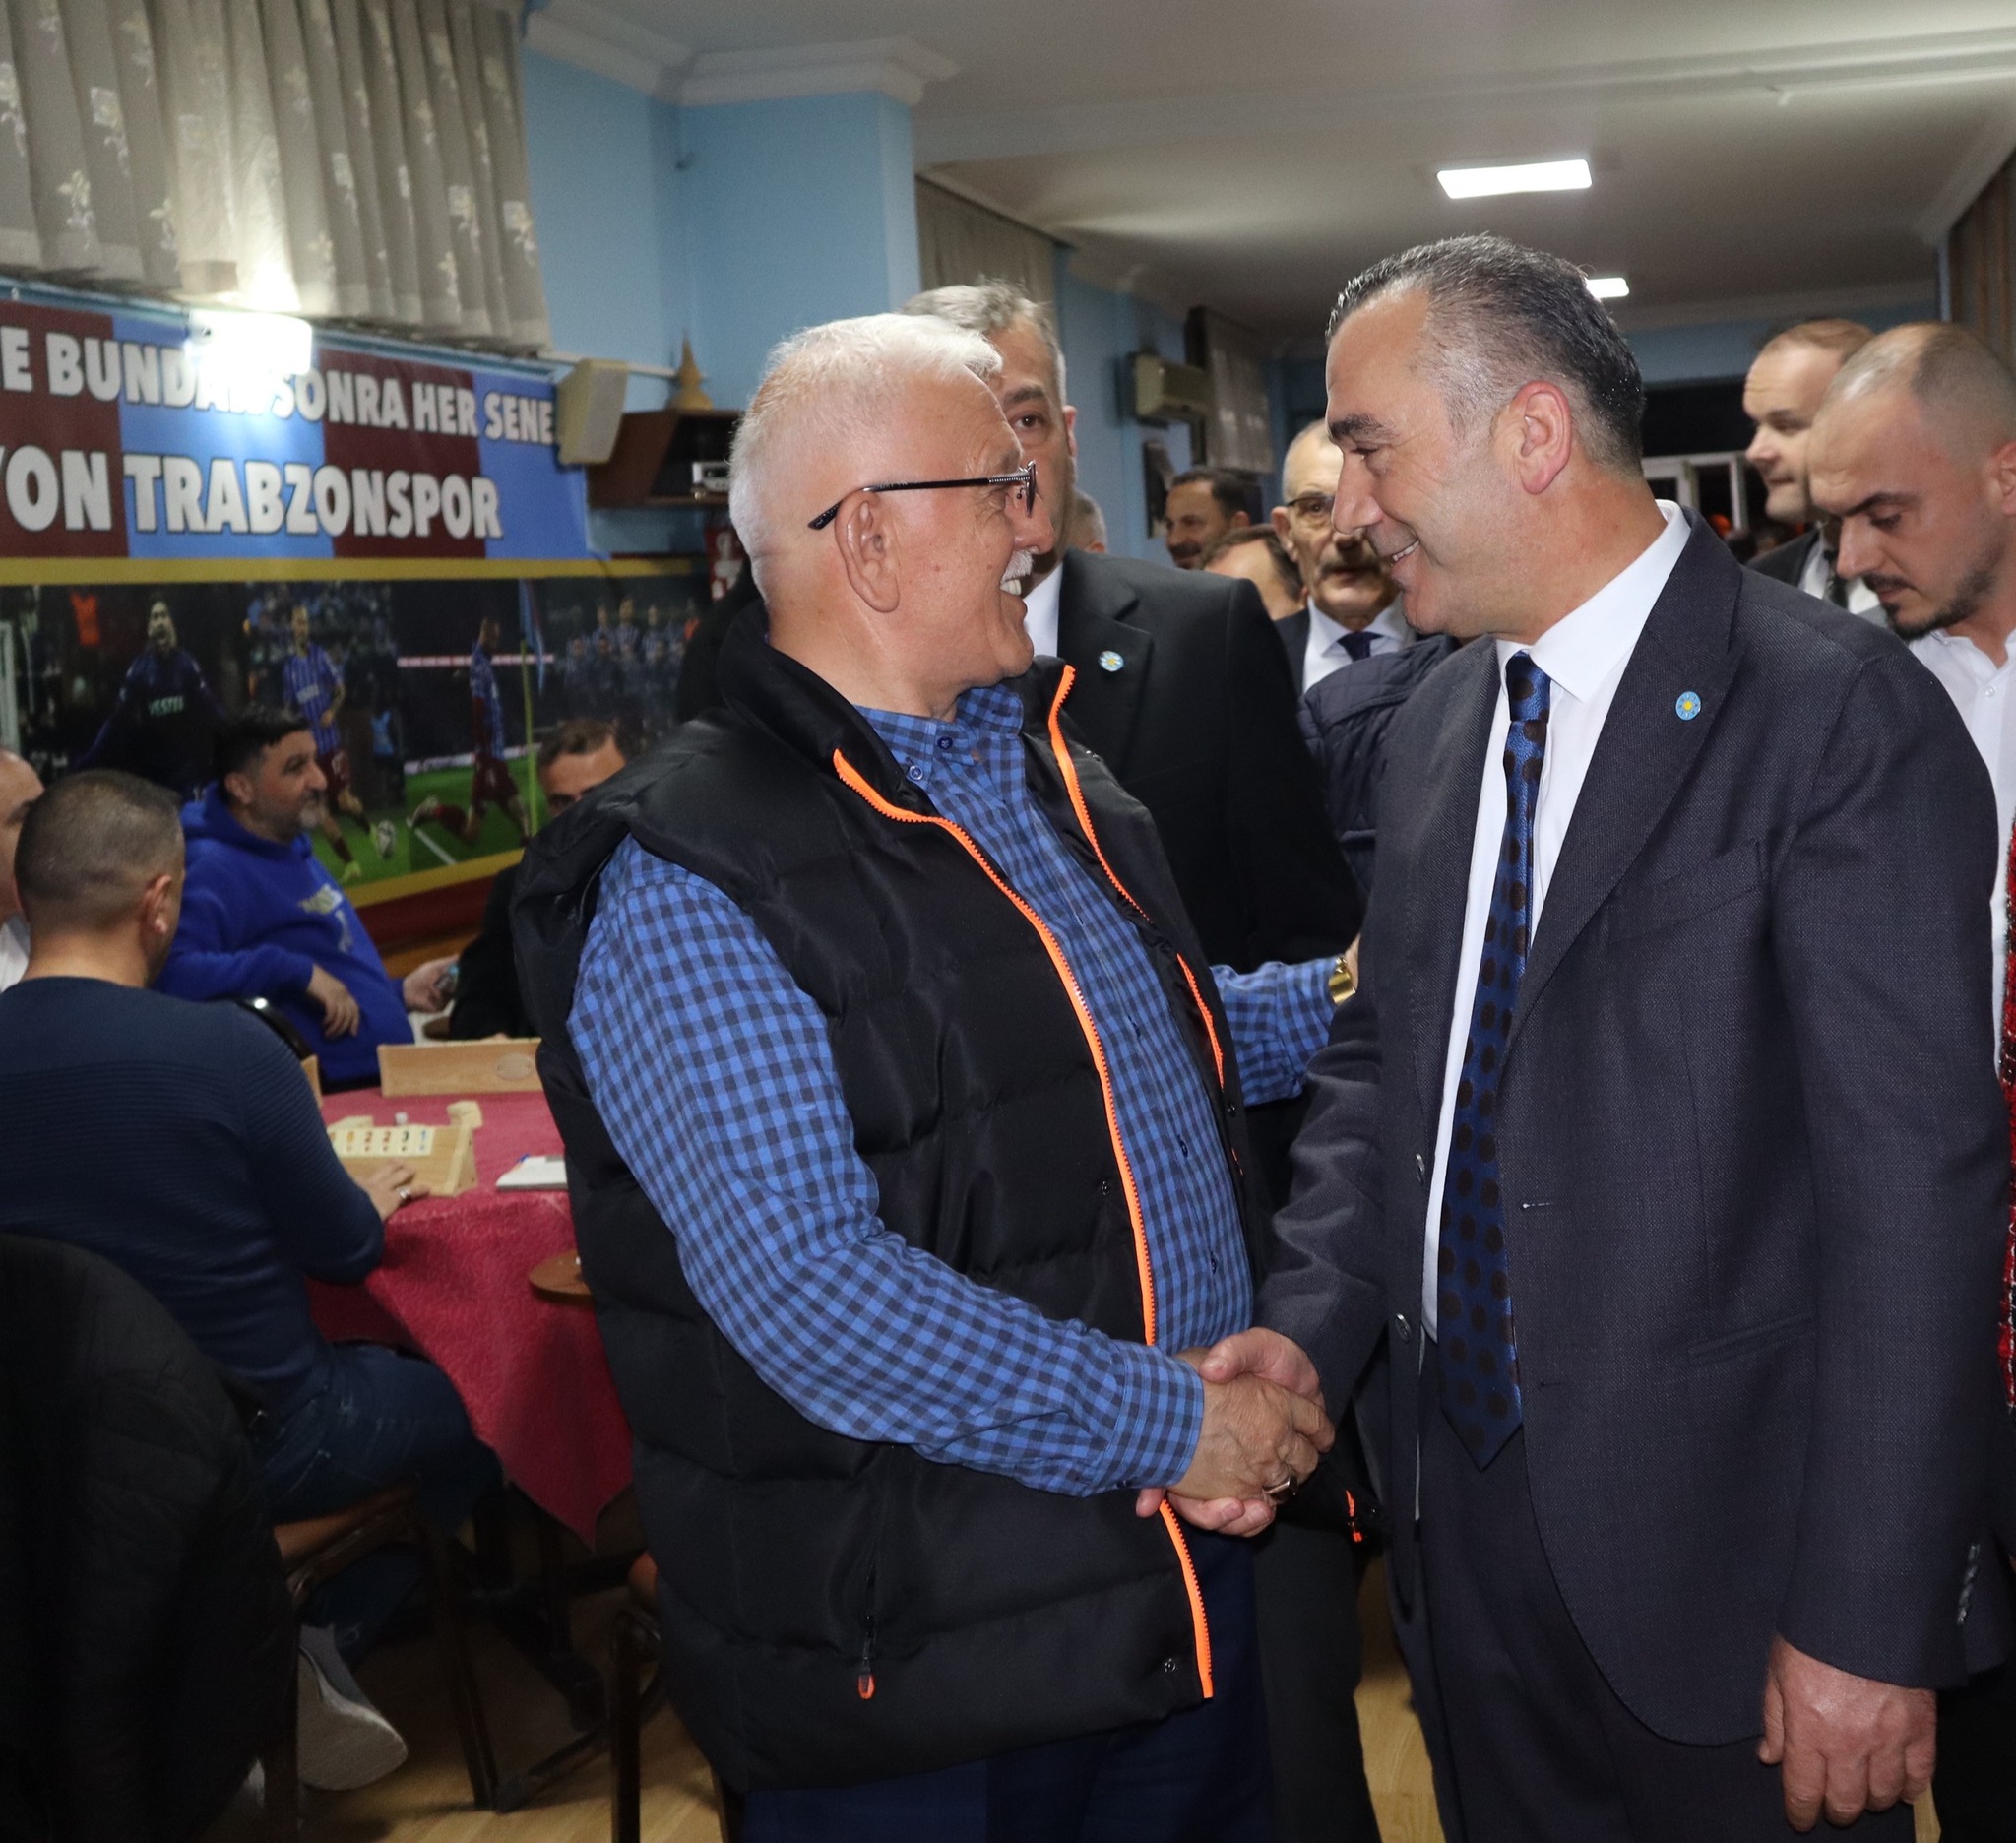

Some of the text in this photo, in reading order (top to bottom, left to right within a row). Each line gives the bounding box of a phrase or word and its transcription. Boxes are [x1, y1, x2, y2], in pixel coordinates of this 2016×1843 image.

[269, 365, 409, 430] SONRA
[411, 381, 478, 437] HER
[483, 391, 553, 444] SENE
[0, 445, 503, 539] ON TRABZONSPOR
